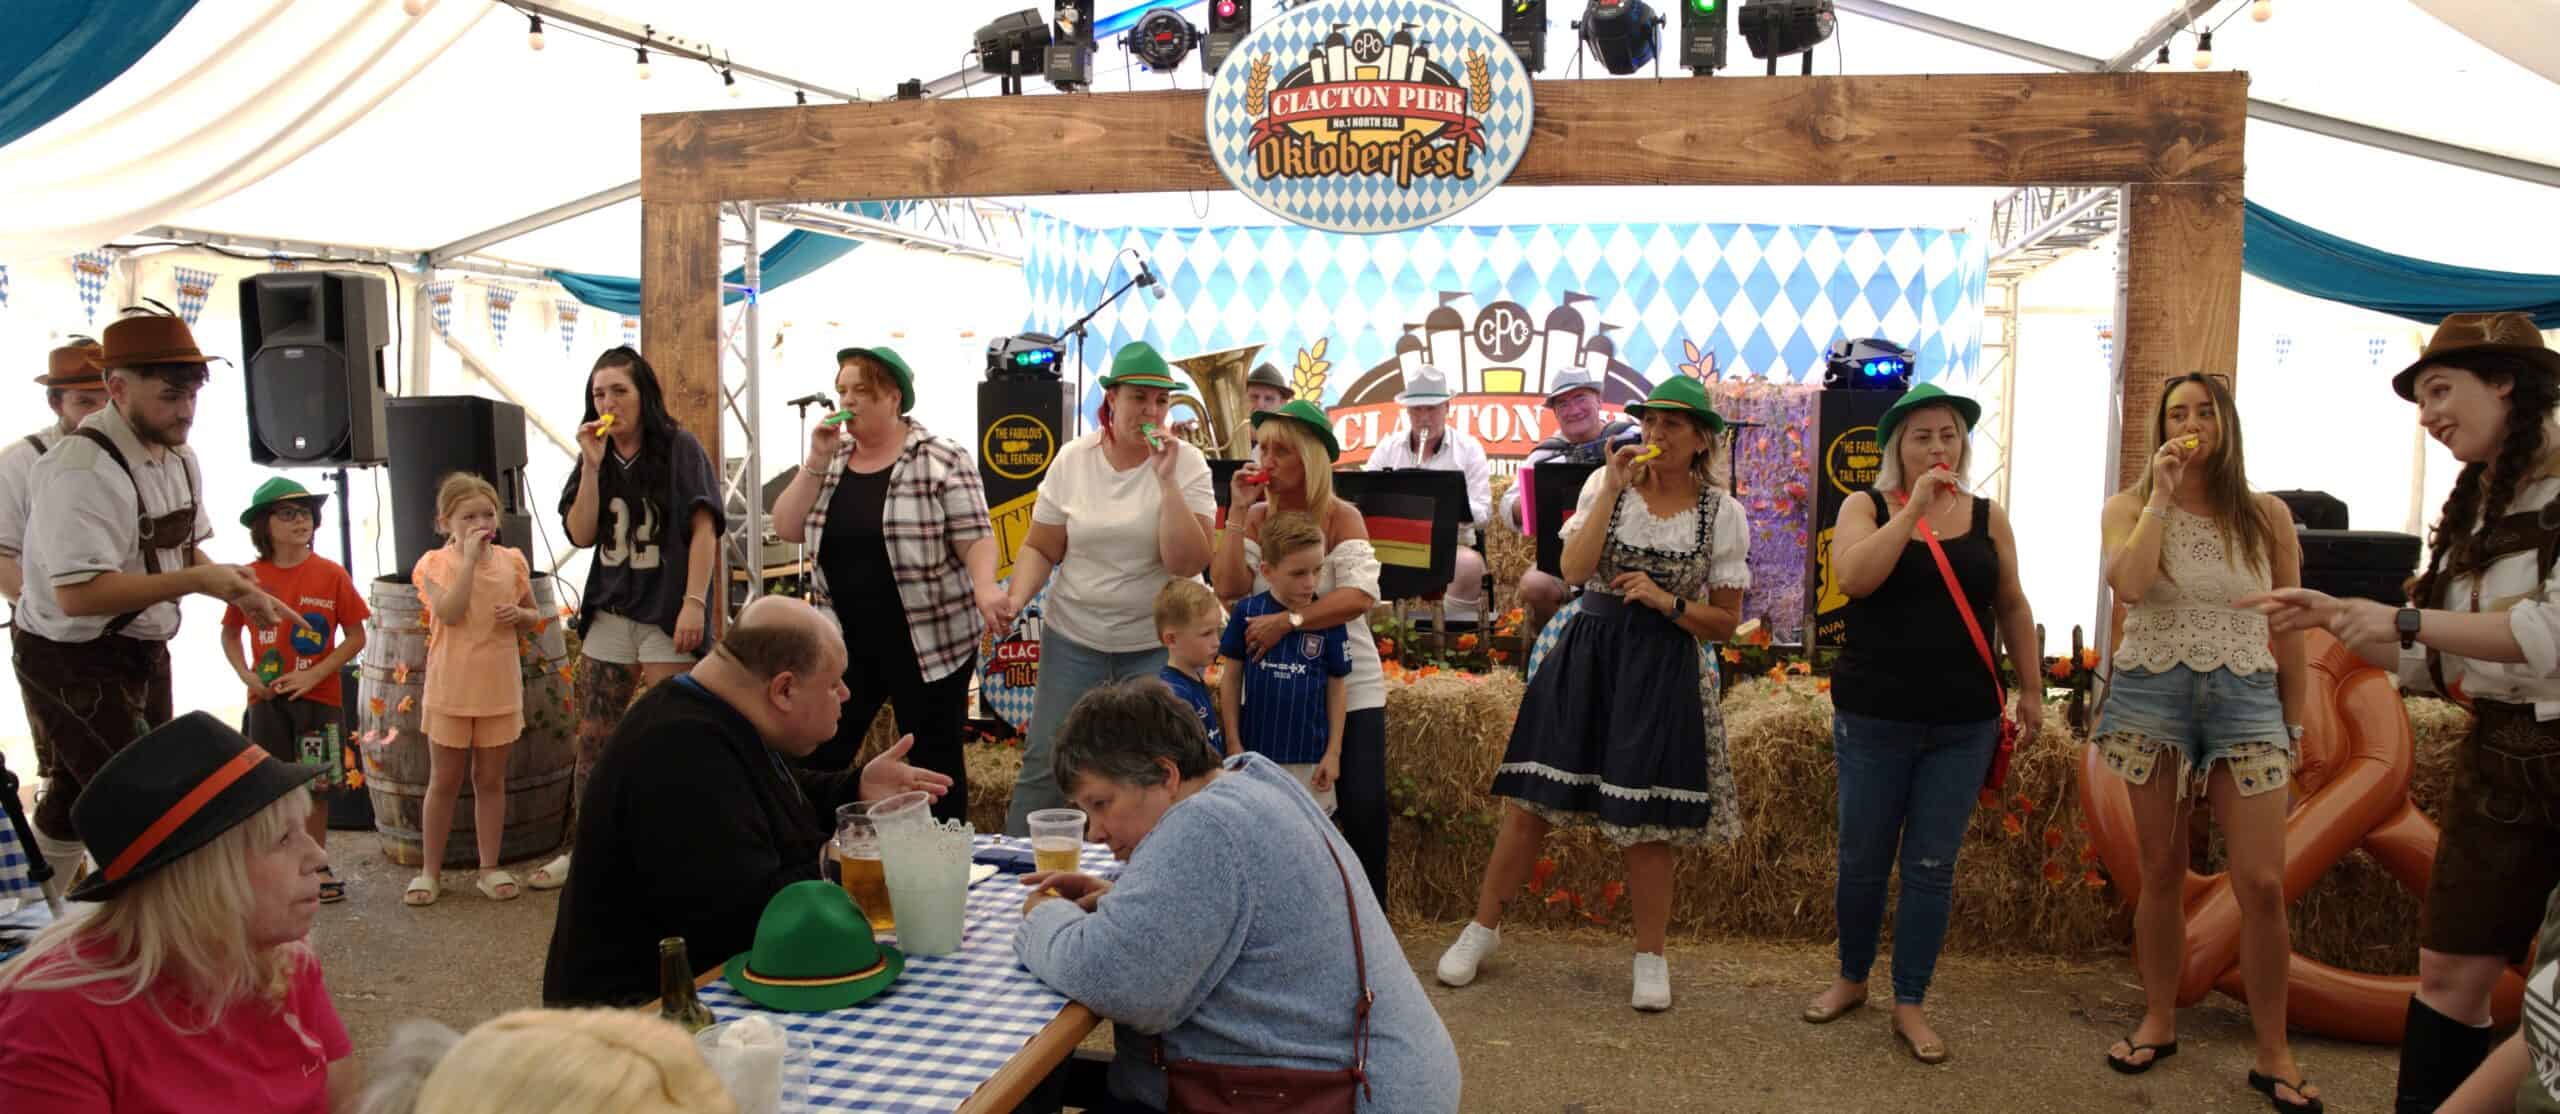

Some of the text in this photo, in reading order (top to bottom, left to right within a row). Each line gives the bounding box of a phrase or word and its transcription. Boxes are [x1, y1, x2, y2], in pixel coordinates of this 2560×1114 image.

[1272, 86, 1464, 116] CLACTON PIER
[1352, 117, 1380, 128] NORTH
[1382, 117, 1398, 128] SEA
[1257, 131, 1473, 189] Oktoberfest
[995, 427, 1043, 440] THE FABULOUS
[1333, 403, 1542, 452] CLATON
[995, 453, 1043, 465] TAIL FEATHERS
[998, 644, 1040, 659] CLAC
